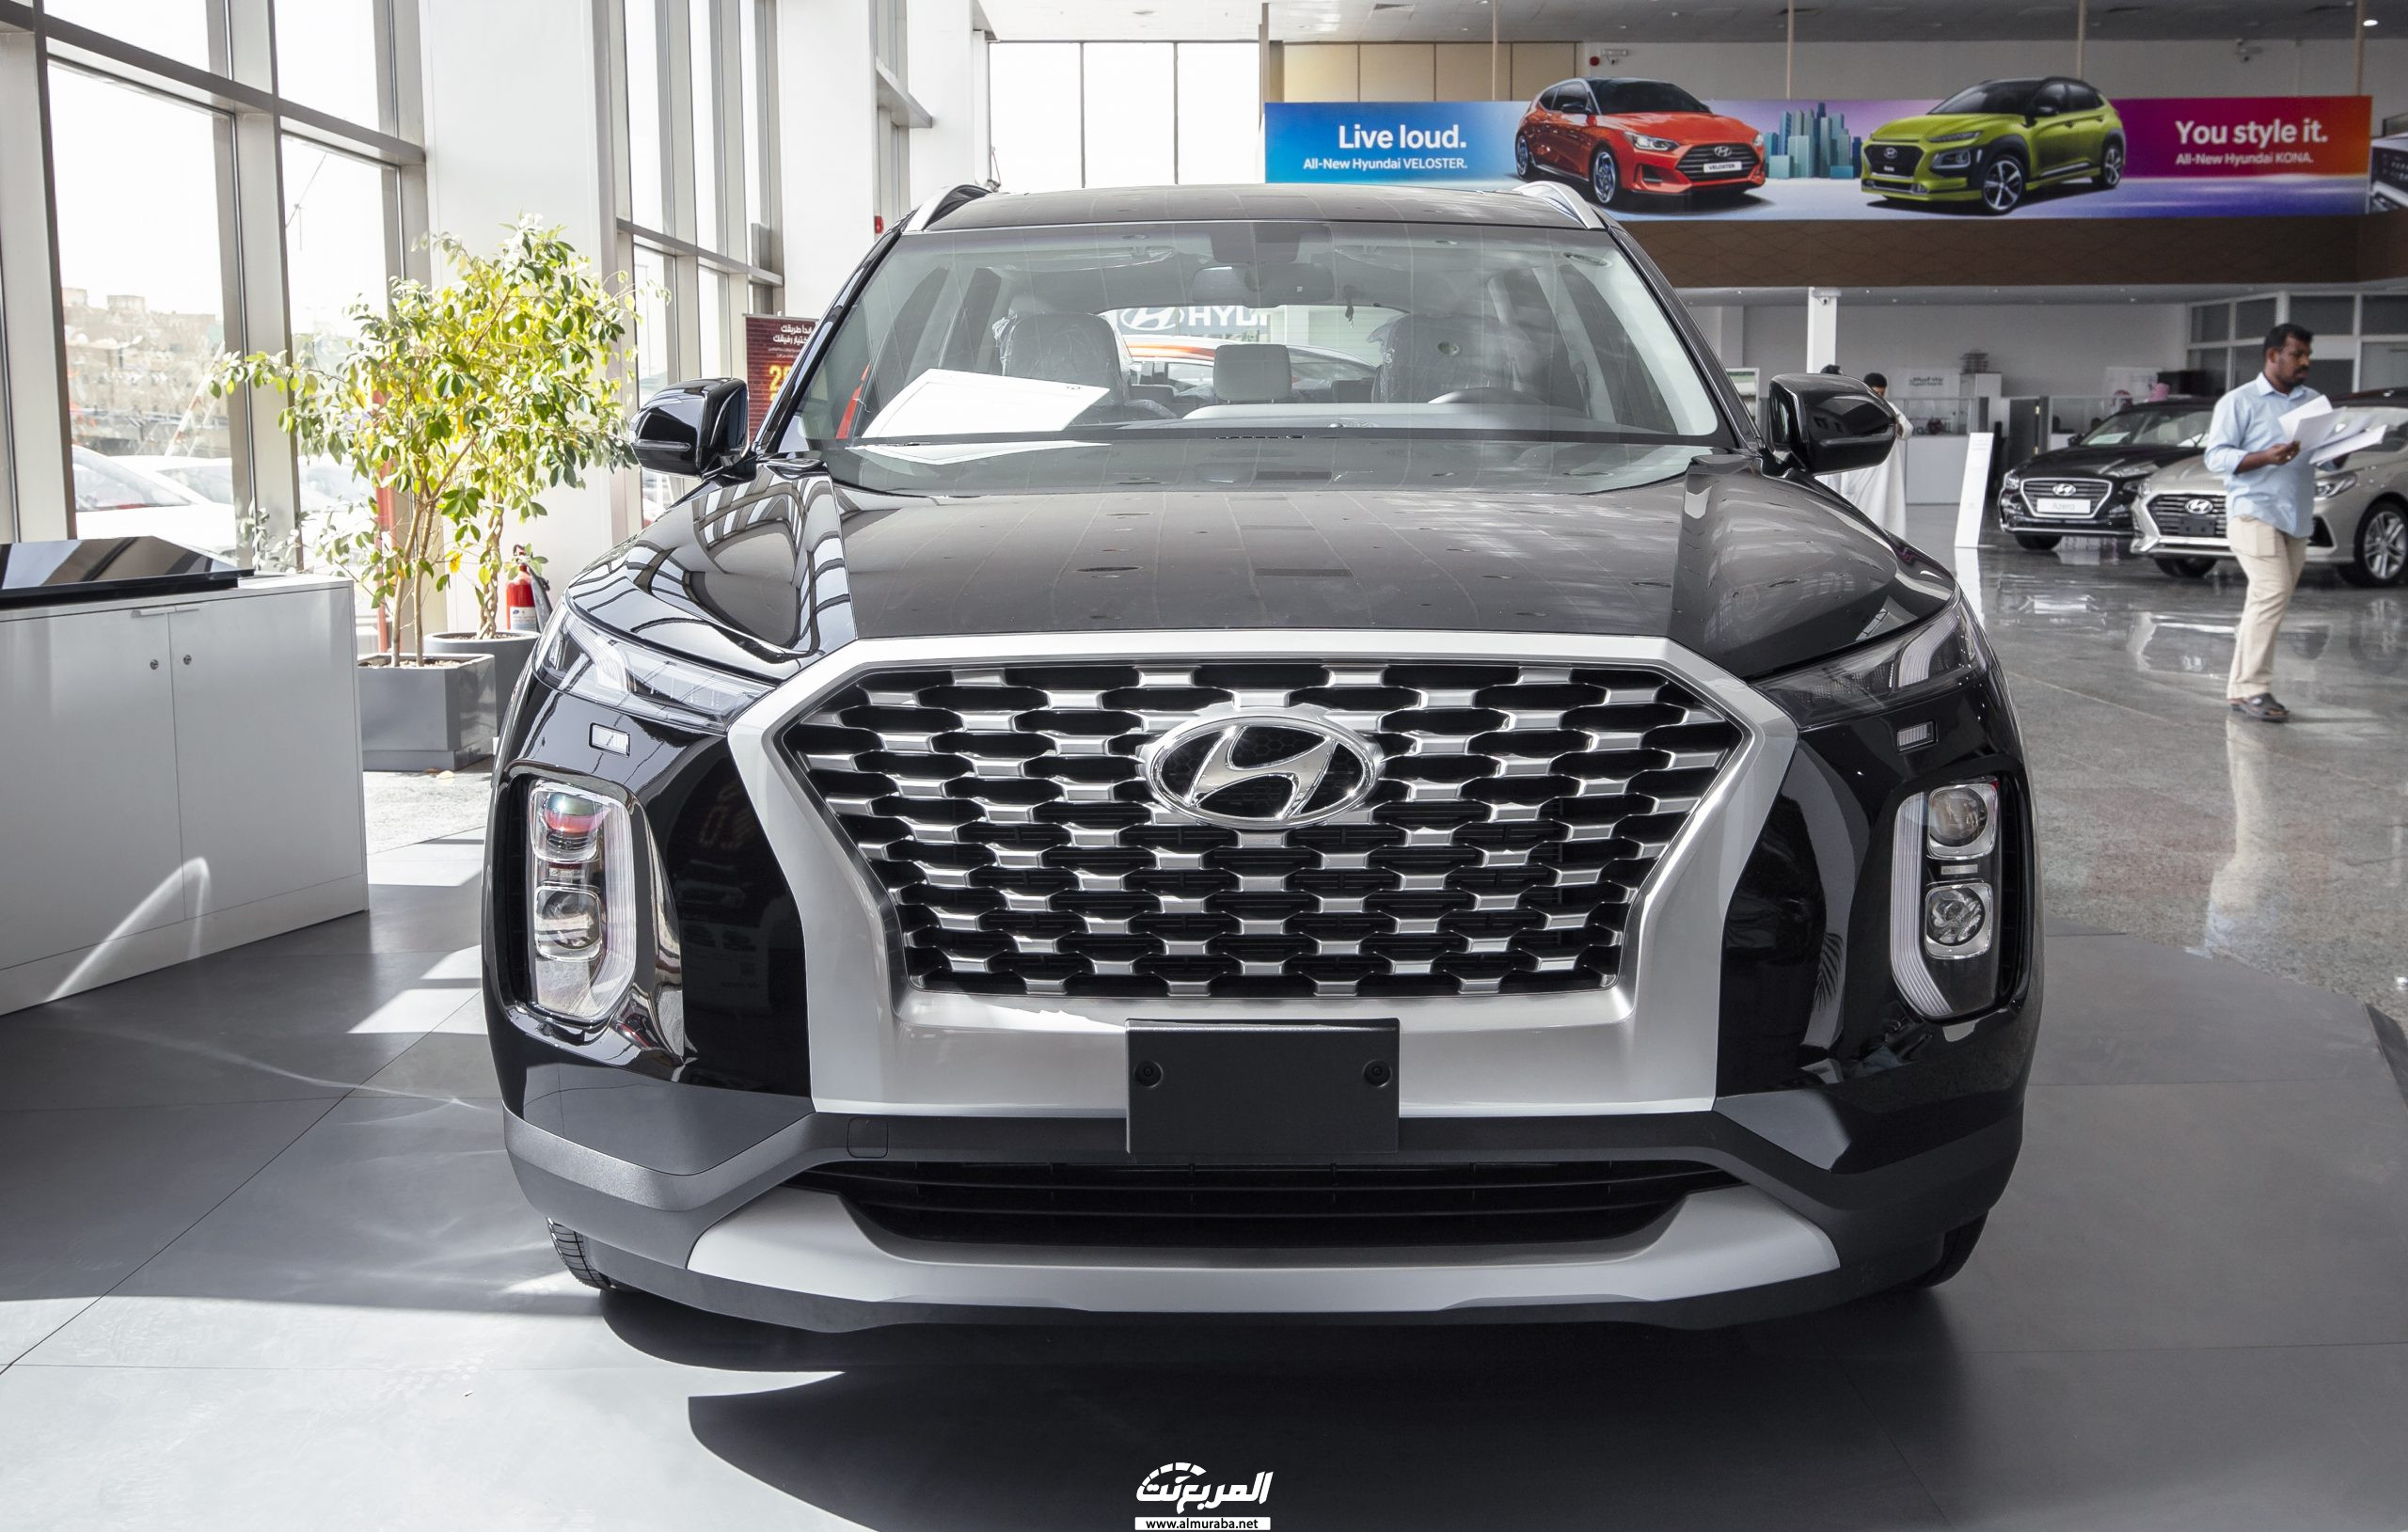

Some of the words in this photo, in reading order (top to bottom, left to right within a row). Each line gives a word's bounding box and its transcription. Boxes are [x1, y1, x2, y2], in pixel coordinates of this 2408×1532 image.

[1339, 124, 1394, 149] Live
[1400, 124, 1467, 149] loud.
[2175, 120, 2228, 145] You
[2233, 118, 2298, 149] style
[2303, 118, 2329, 143] it.
[1303, 157, 1350, 170] All-New
[1353, 157, 1402, 171] Hyundai
[1402, 157, 1467, 169] VELOSTER.
[2176, 152, 2223, 166] All-New
[2225, 152, 2273, 167] Hyundai
[2275, 151, 2314, 165] KONA.
